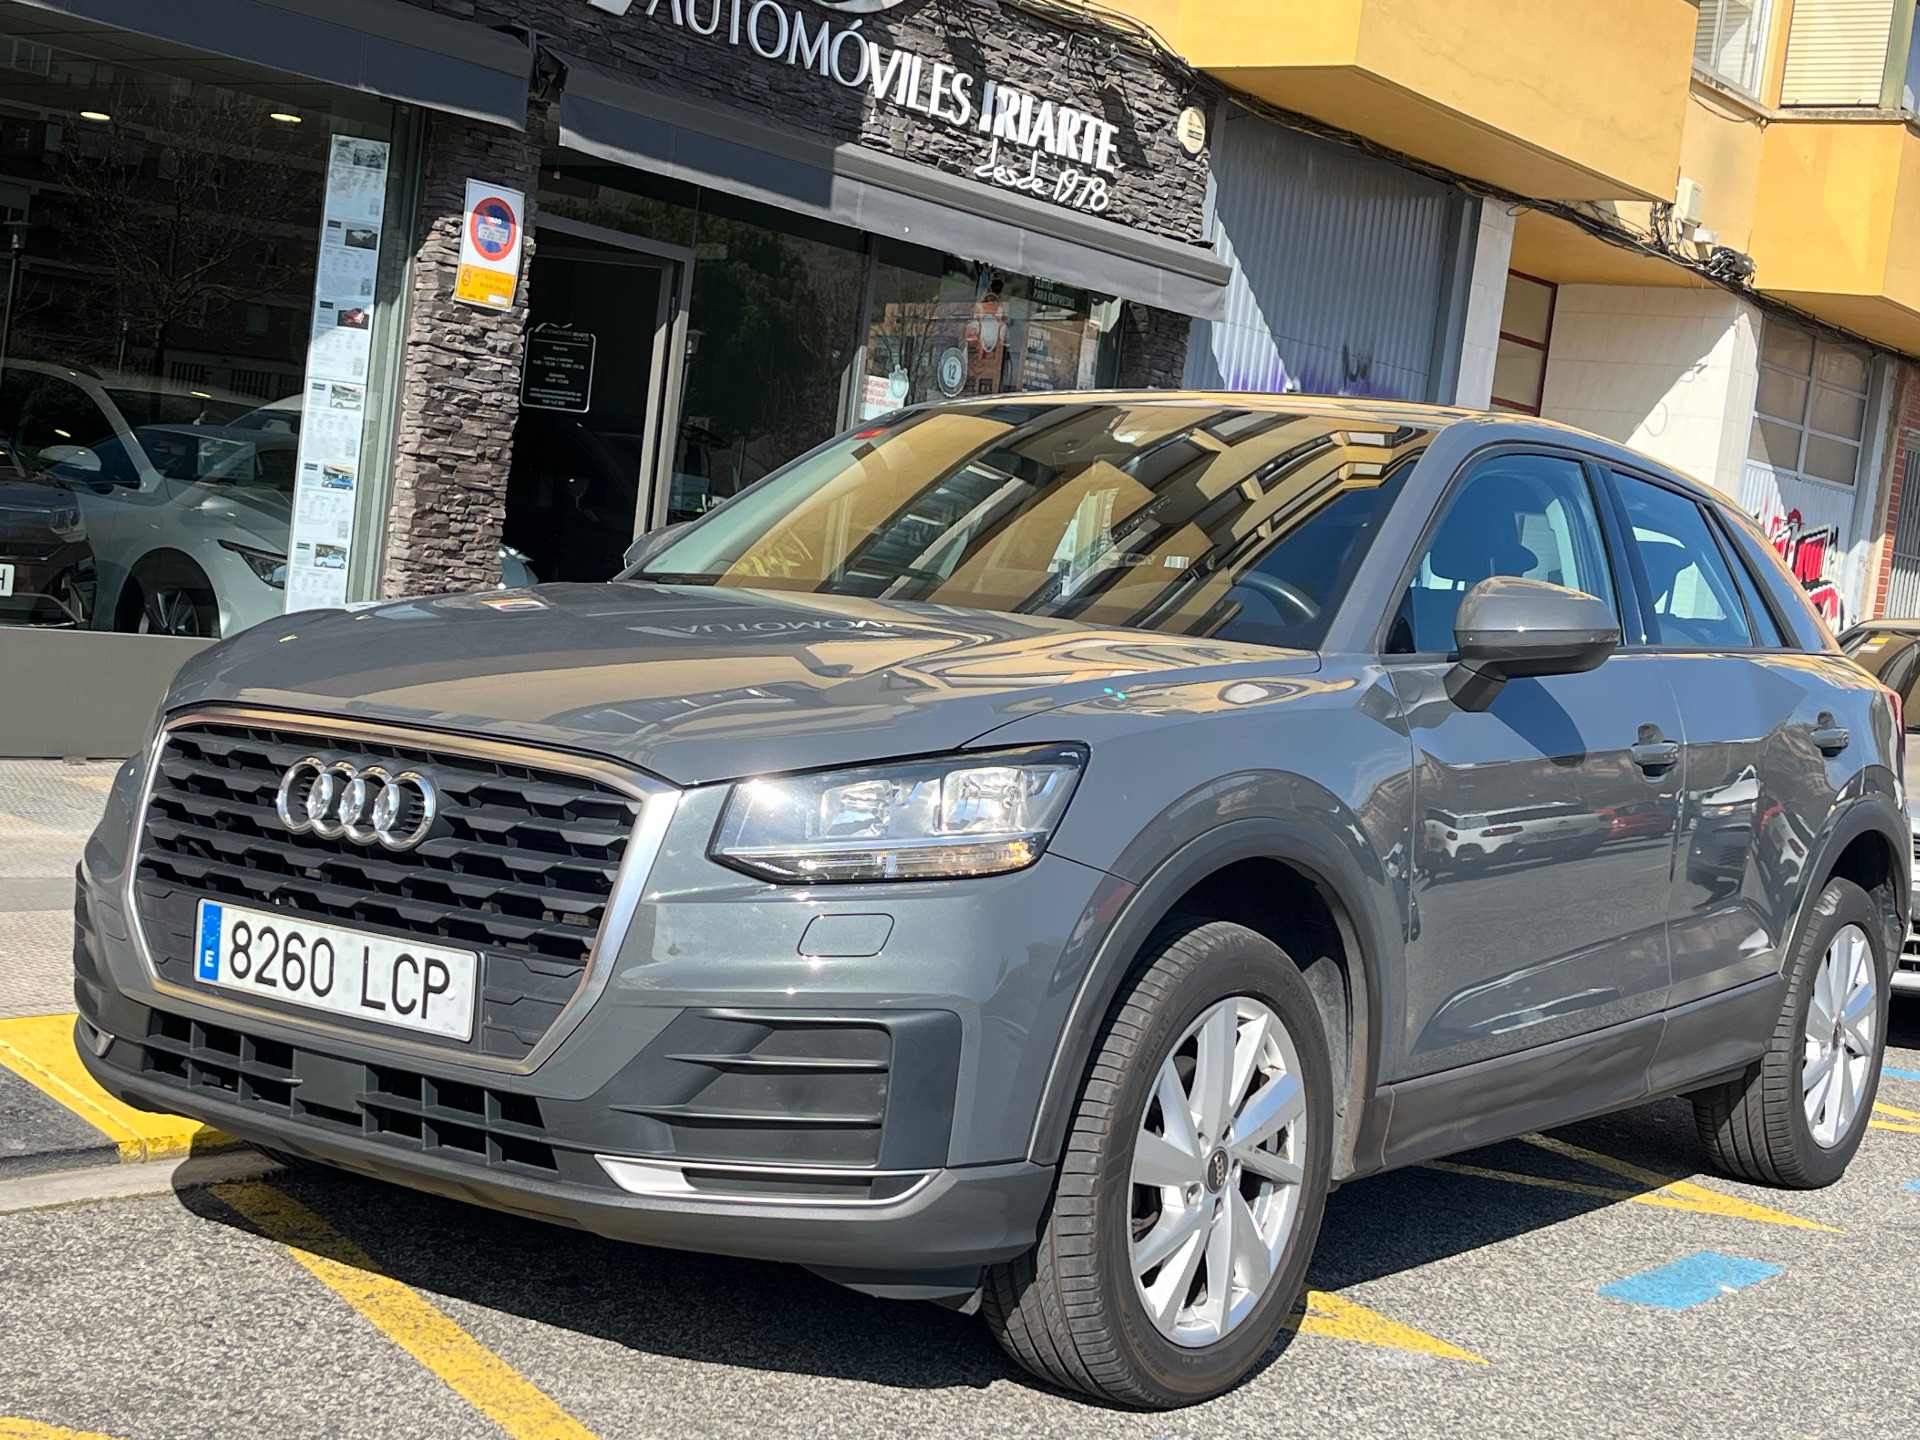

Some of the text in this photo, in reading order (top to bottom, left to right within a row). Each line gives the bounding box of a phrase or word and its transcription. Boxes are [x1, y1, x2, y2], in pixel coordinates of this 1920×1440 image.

[978, 80, 1120, 174] IRIARTE
[974, 138, 1109, 213] desde 1978
[948, 364, 957, 380] 12
[204, 949, 215, 968] E
[229, 920, 451, 1019] 8260 LCP
